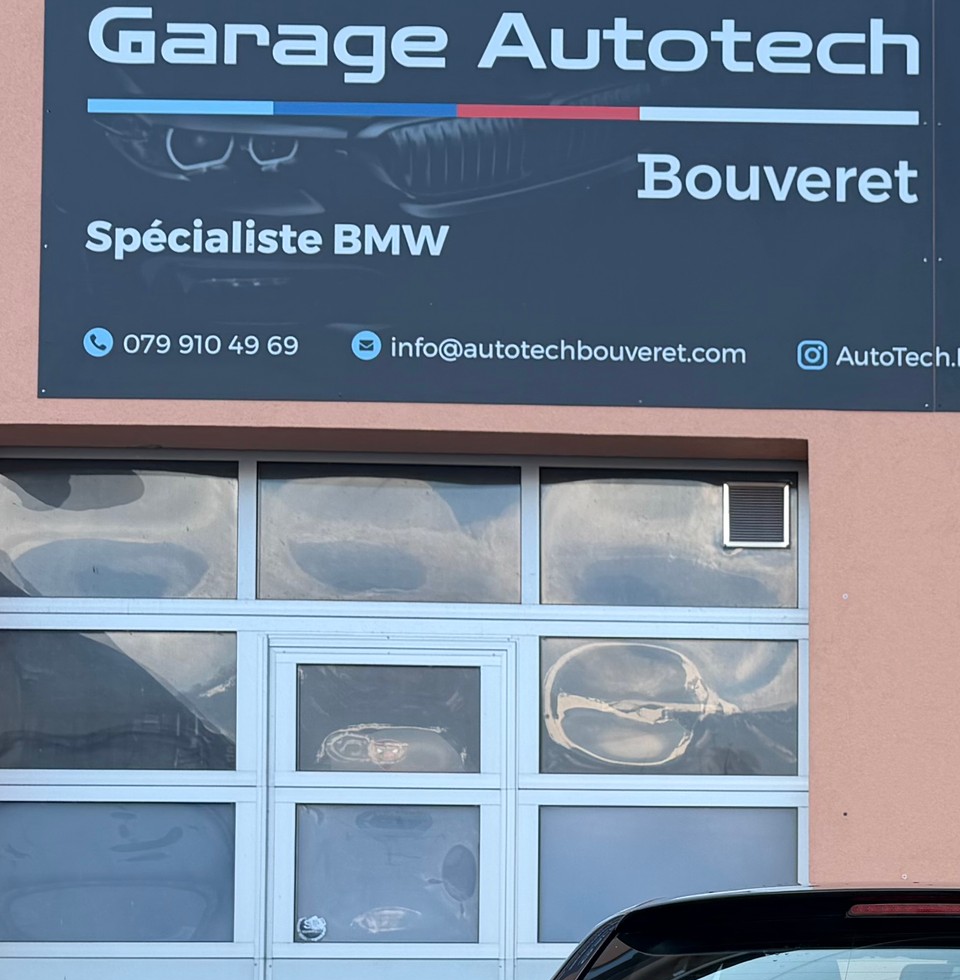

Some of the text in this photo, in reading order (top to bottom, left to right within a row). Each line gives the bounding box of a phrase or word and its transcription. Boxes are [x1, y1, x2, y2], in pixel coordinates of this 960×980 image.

[88, 6, 920, 84] Garage Autotech
[637, 153, 919, 204] Bouveret
[85, 218, 450, 260] Spécialiste BMW
[123, 334, 299, 356] 079 910 49 69
[390, 336, 746, 364] info@autotechbouveret.com
